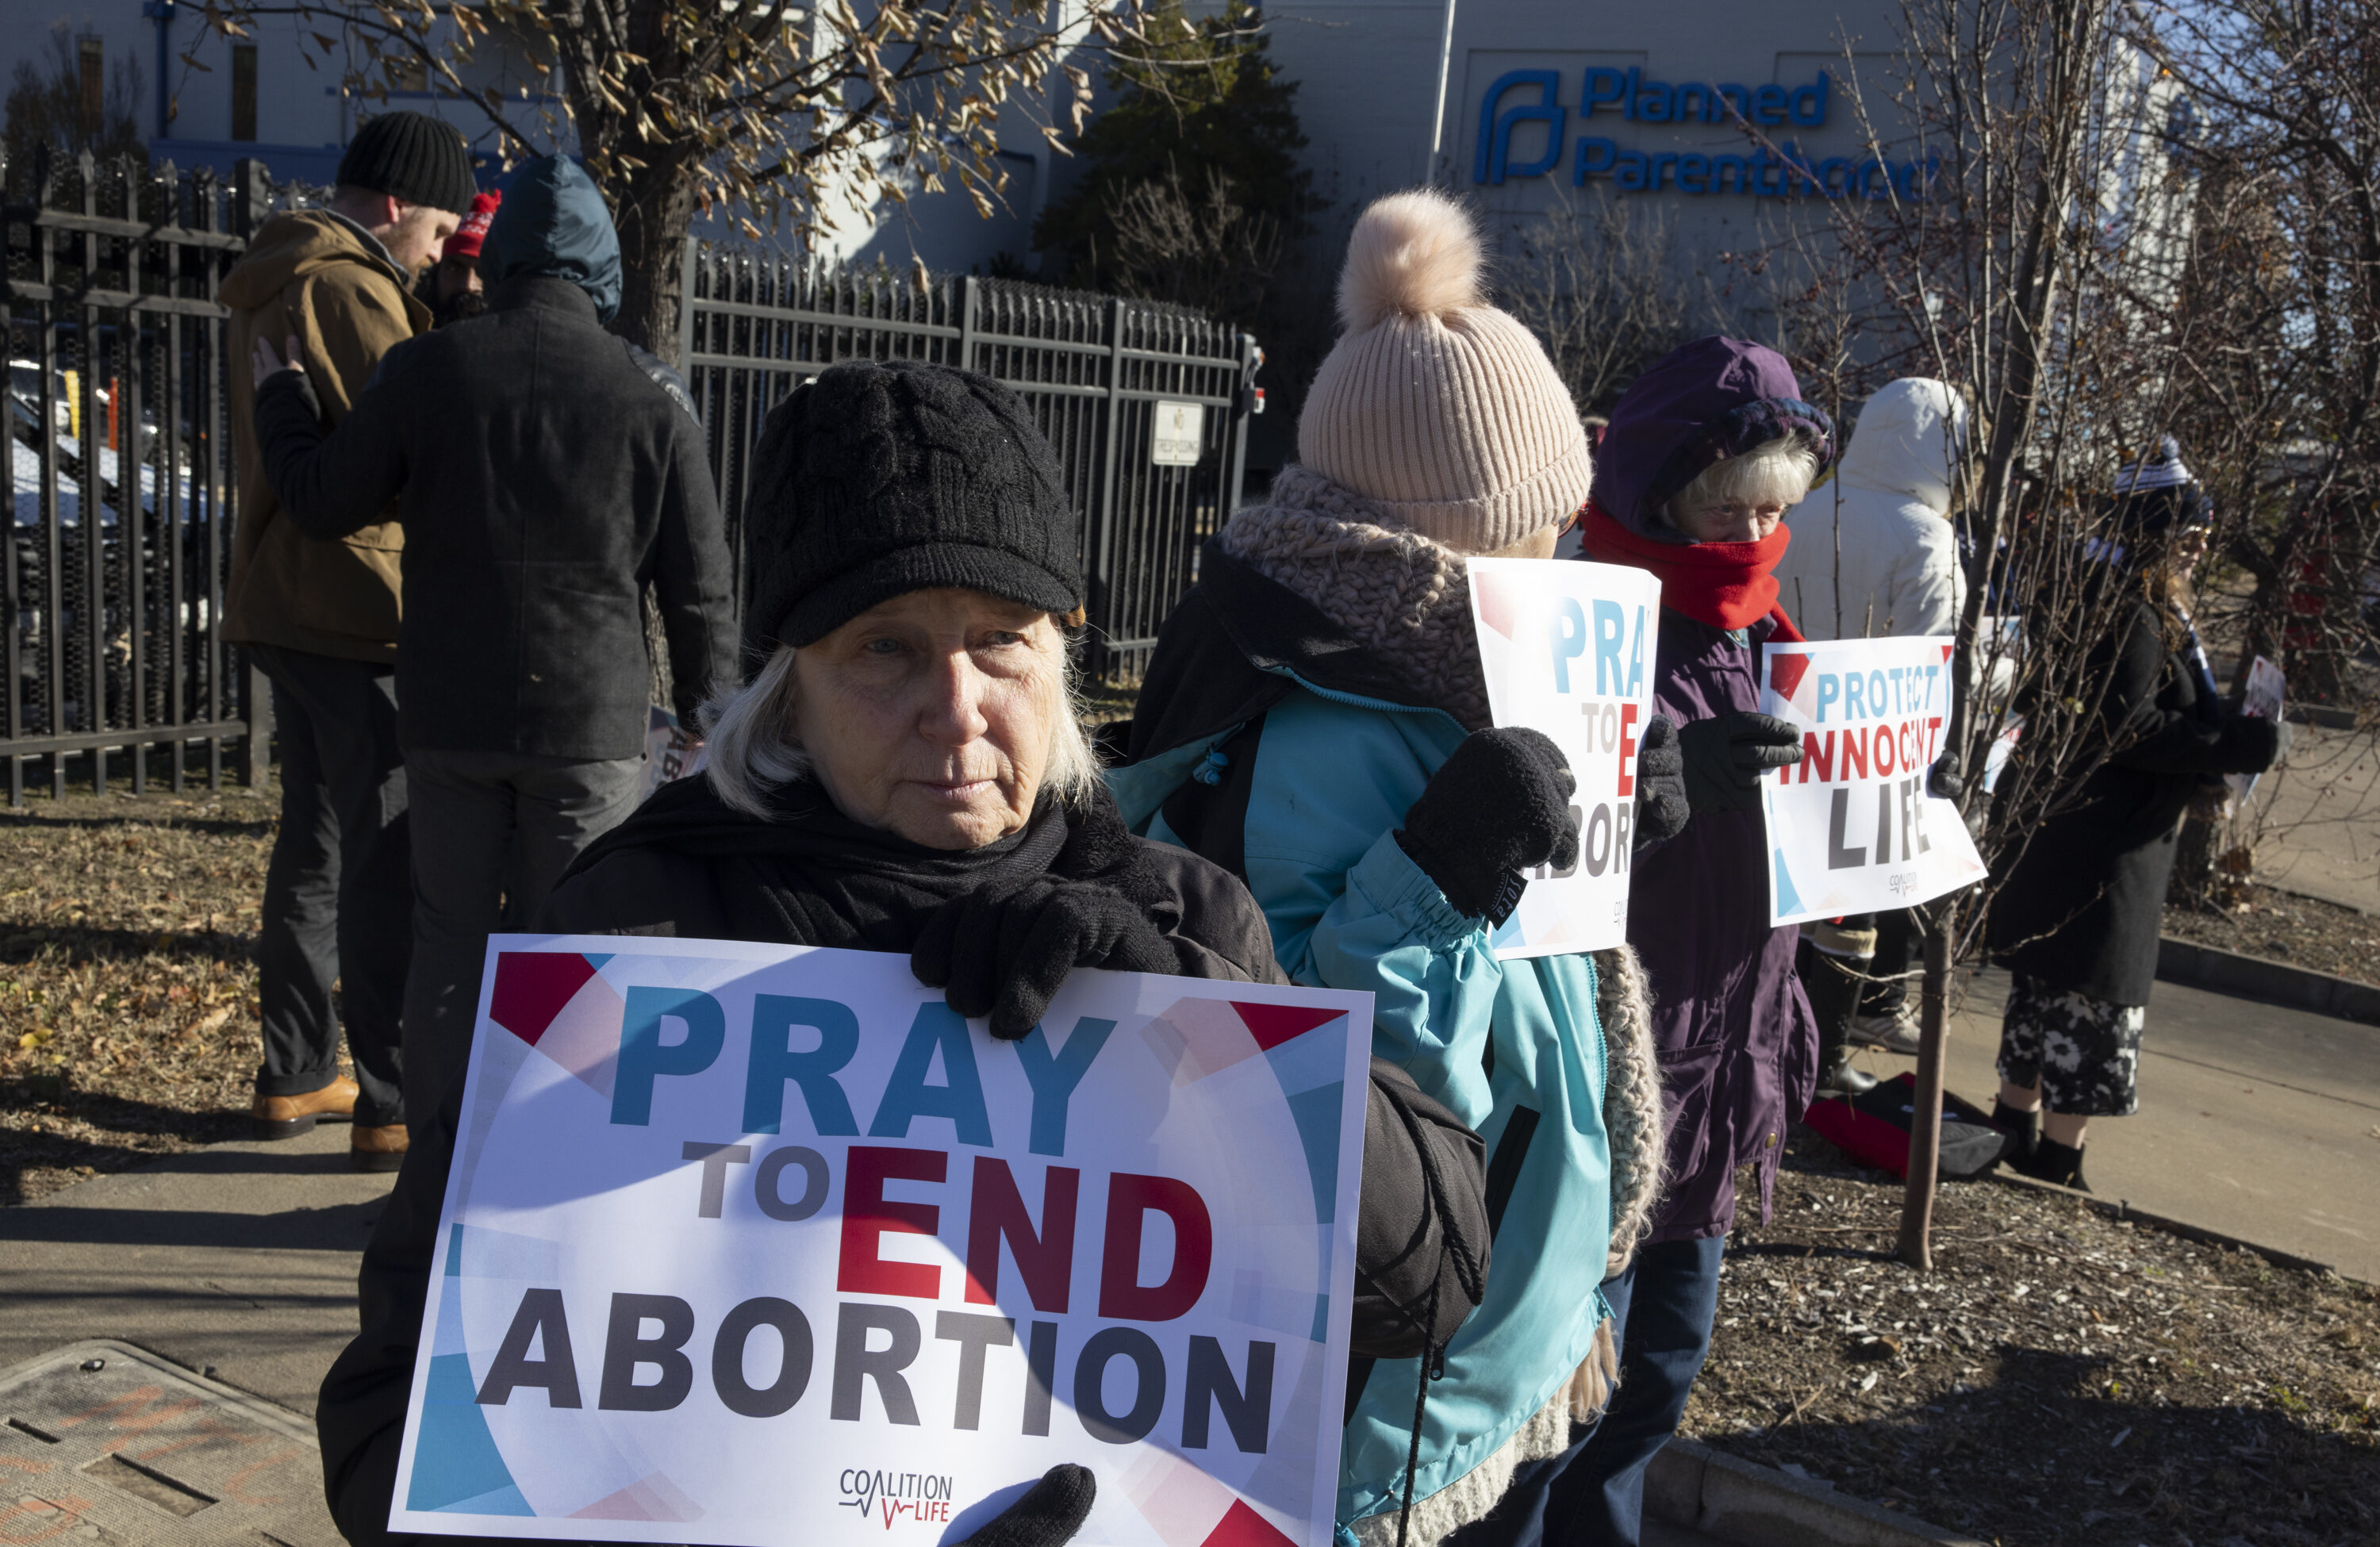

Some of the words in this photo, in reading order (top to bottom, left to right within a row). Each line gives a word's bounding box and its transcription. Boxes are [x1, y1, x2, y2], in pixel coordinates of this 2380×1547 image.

[1580, 67, 1829, 125] Planned
[1573, 136, 1942, 202] Parenthood
[1549, 597, 1649, 697] PRA
[1817, 666, 1938, 723] PROTECT
[1581, 703, 1618, 754] TO
[1829, 774, 1931, 869] LIFE
[609, 985, 1118, 1157] PRAY
[681, 1141, 831, 1222] TO
[836, 1146, 1213, 1322] END
[475, 1288, 1276, 1454] ABORTION
[839, 1468, 952, 1503] COALITION
[915, 1500, 950, 1522] LIFE
